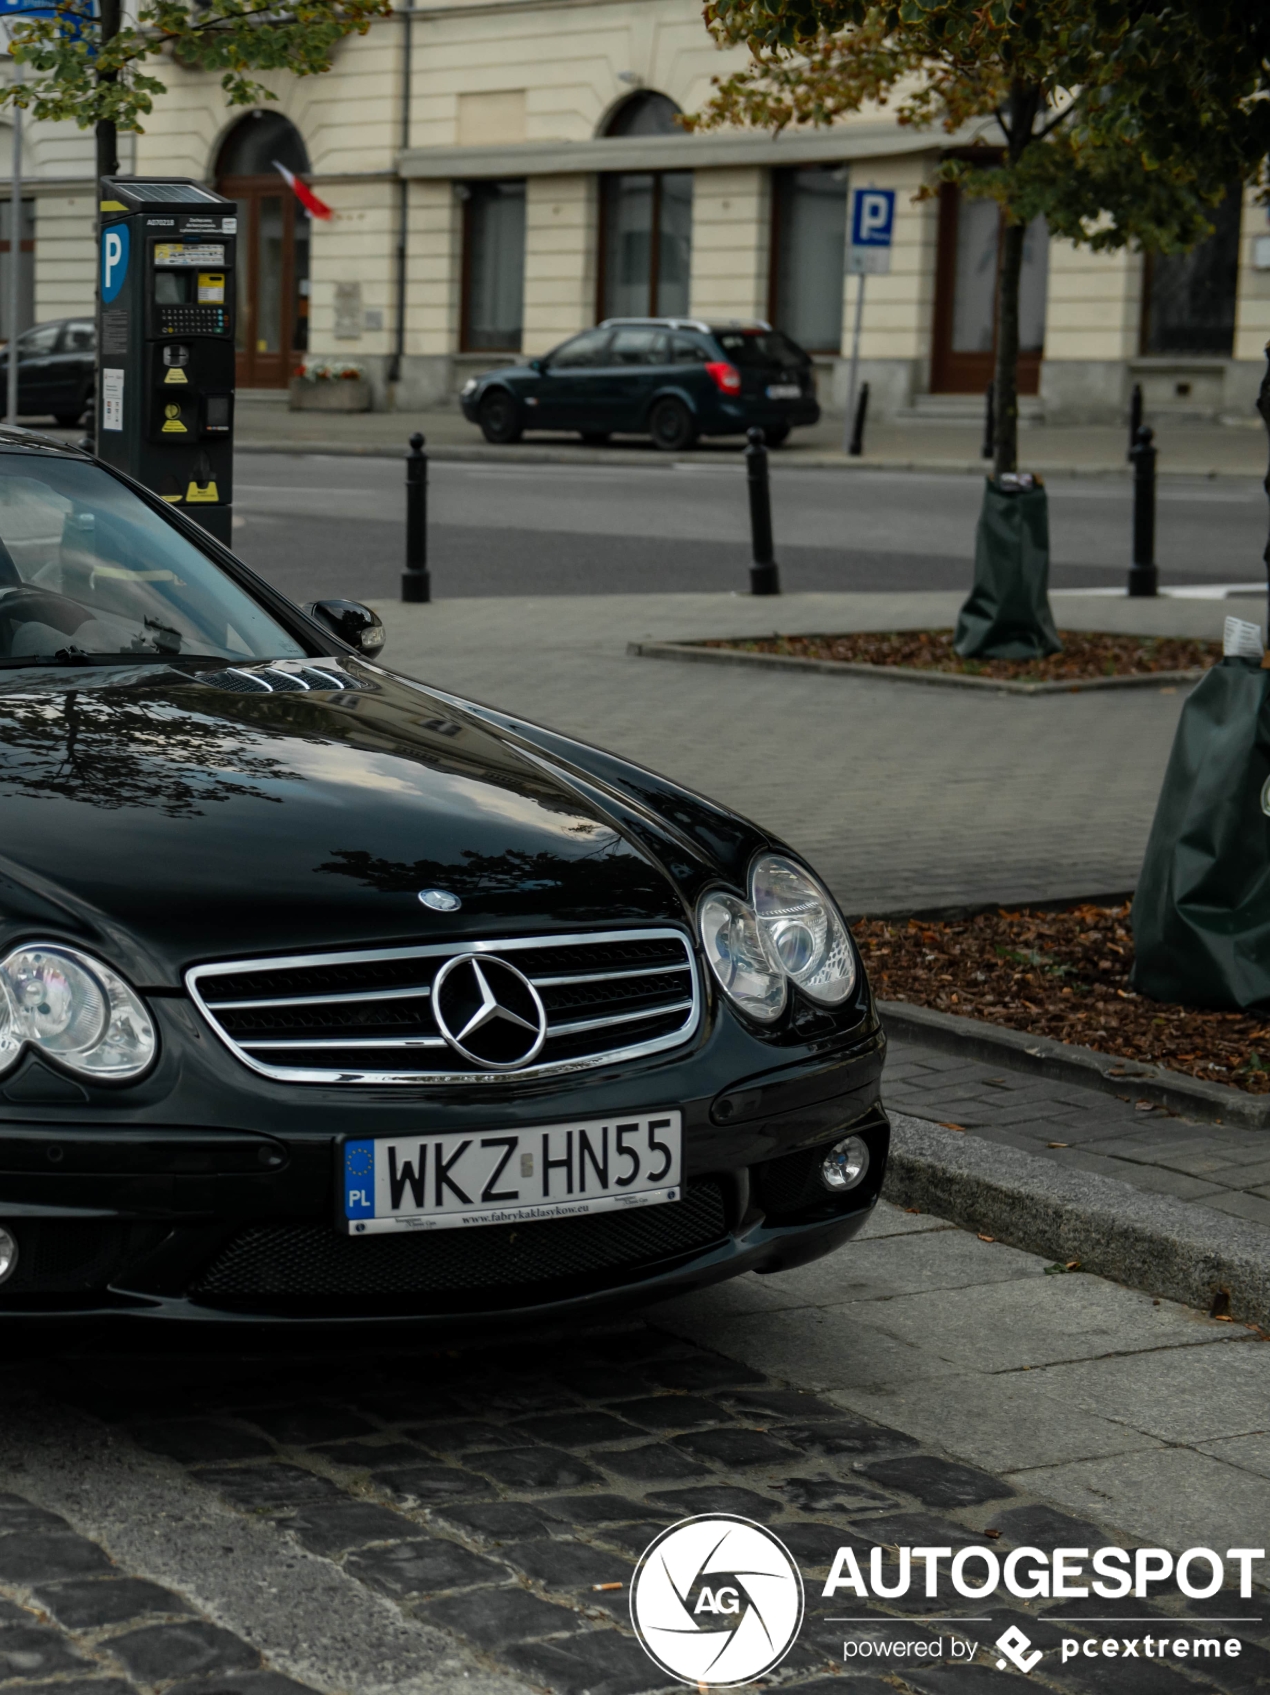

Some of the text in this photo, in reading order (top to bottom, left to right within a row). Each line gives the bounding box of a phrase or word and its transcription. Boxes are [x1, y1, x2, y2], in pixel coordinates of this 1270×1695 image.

[859, 194, 888, 240] P
[105, 233, 122, 288] P
[388, 1118, 673, 1210] WKZ HN55
[349, 1189, 371, 1207] PL
[462, 1204, 589, 1225] www.fabrykaklasykow.eu
